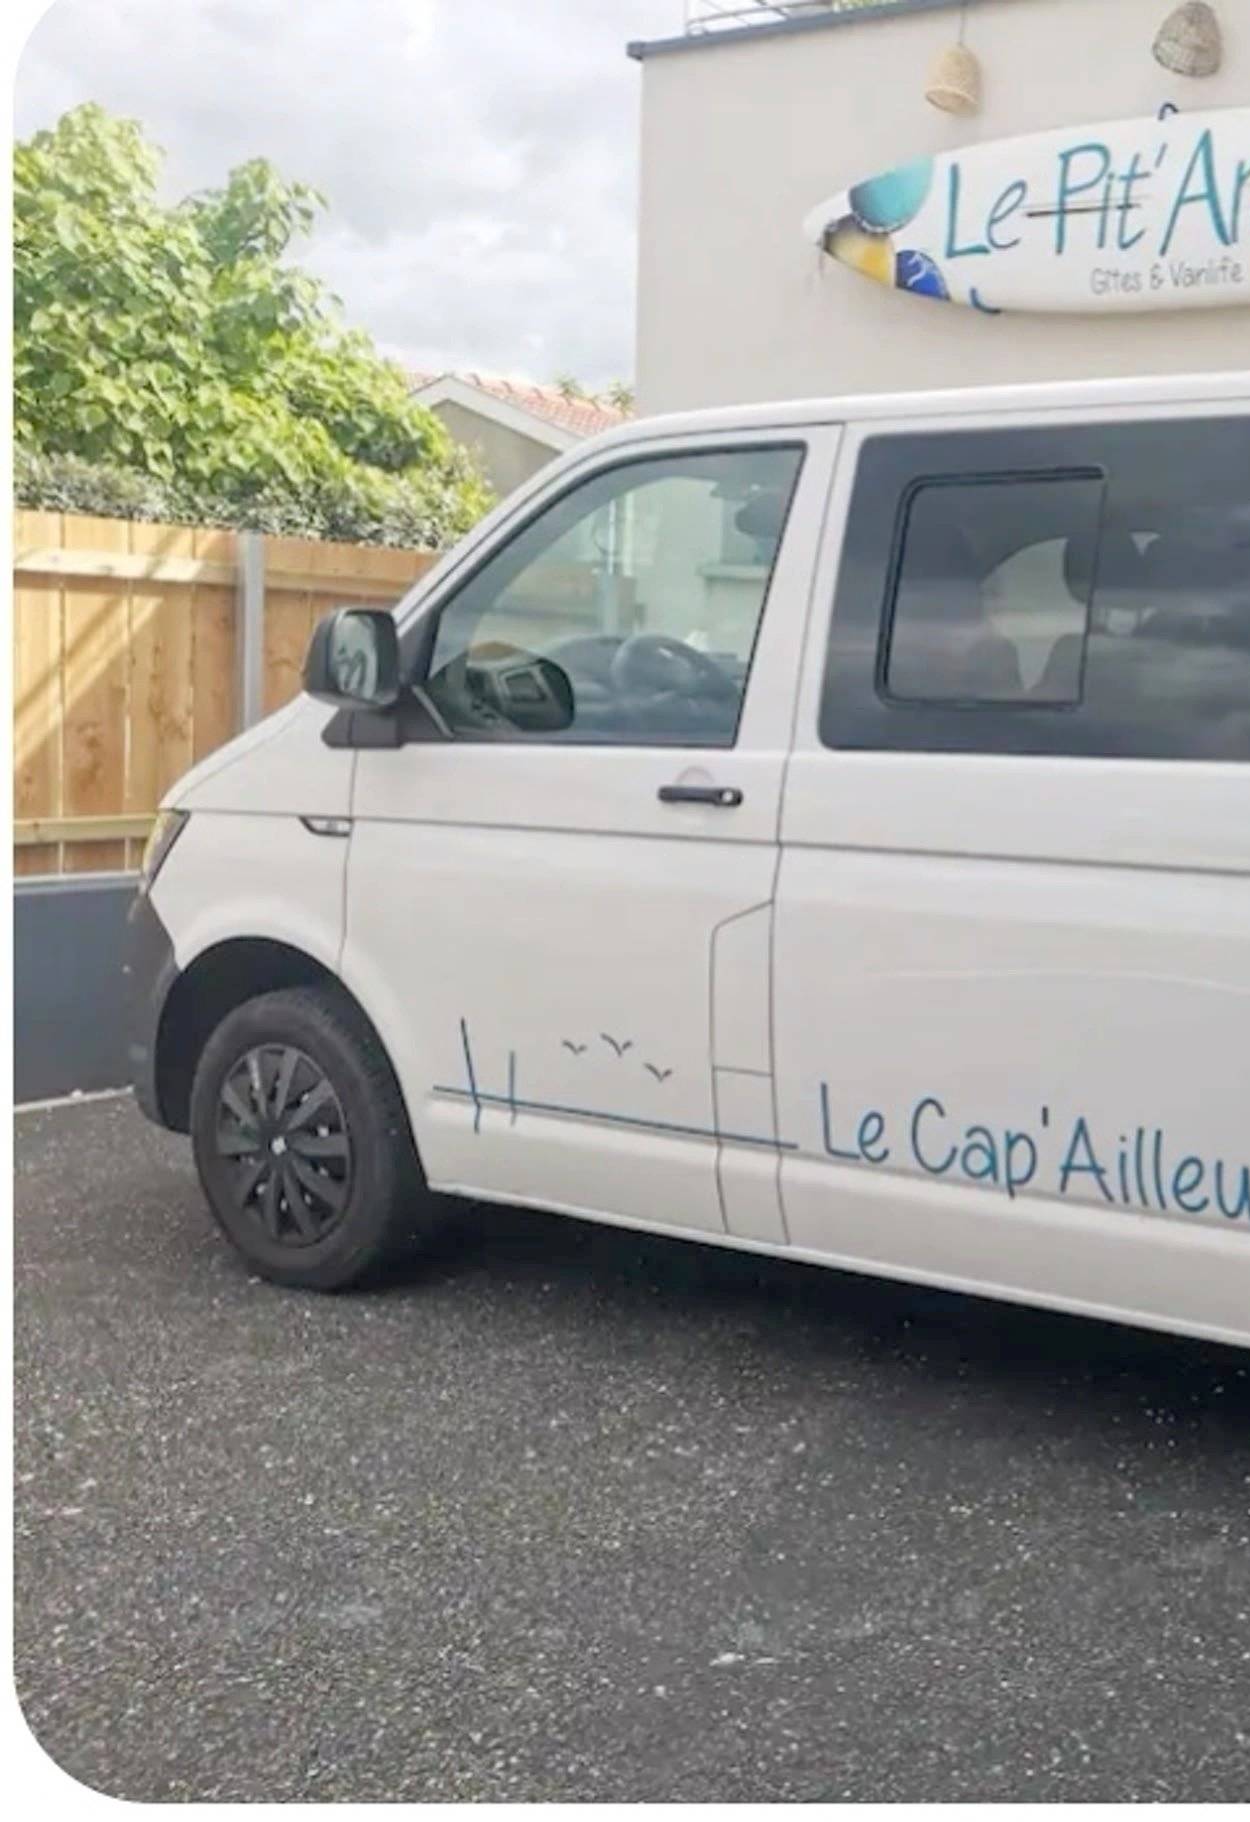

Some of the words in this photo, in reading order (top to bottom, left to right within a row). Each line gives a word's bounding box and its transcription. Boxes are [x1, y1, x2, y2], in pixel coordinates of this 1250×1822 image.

[945, 162, 1028, 259] Le
[1150, 262, 1165, 290] &
[820, 1081, 890, 1163] Le
